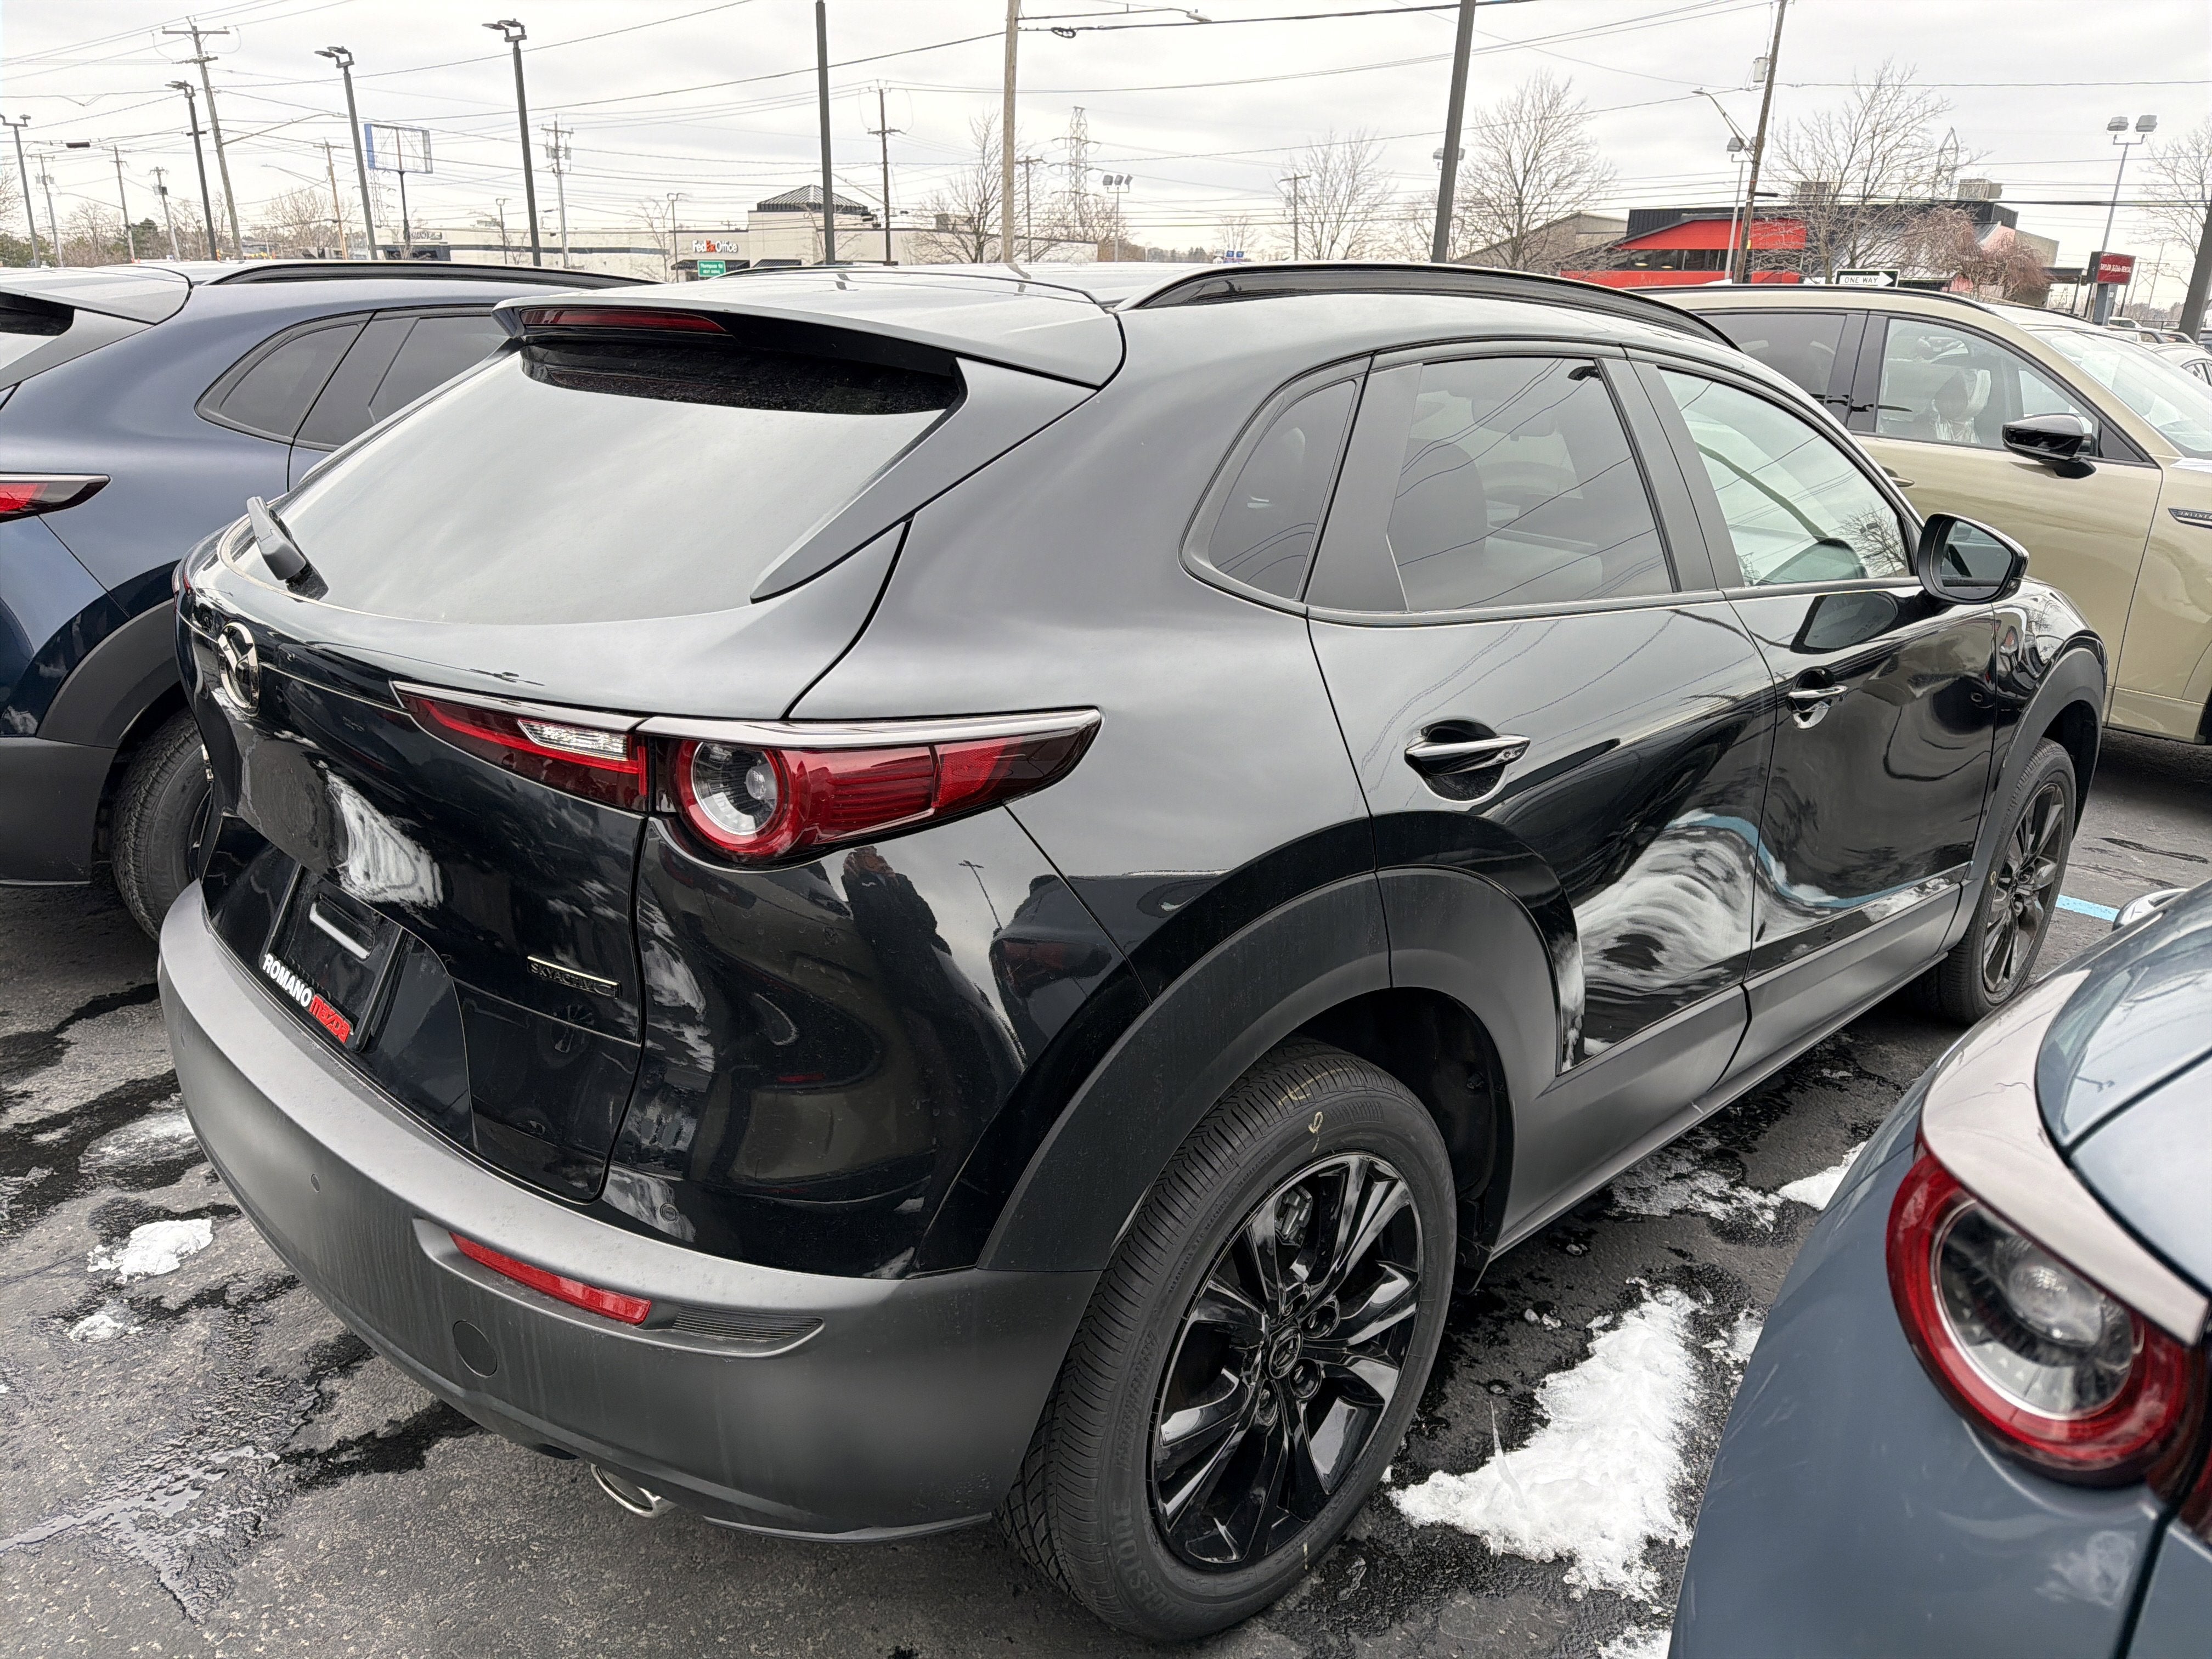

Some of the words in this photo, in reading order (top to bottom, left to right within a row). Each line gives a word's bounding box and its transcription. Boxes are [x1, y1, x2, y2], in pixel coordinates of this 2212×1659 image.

[692, 239, 715, 253] FedEx
[715, 240, 738, 253] Office
[262, 953, 312, 1007] ROMANO
